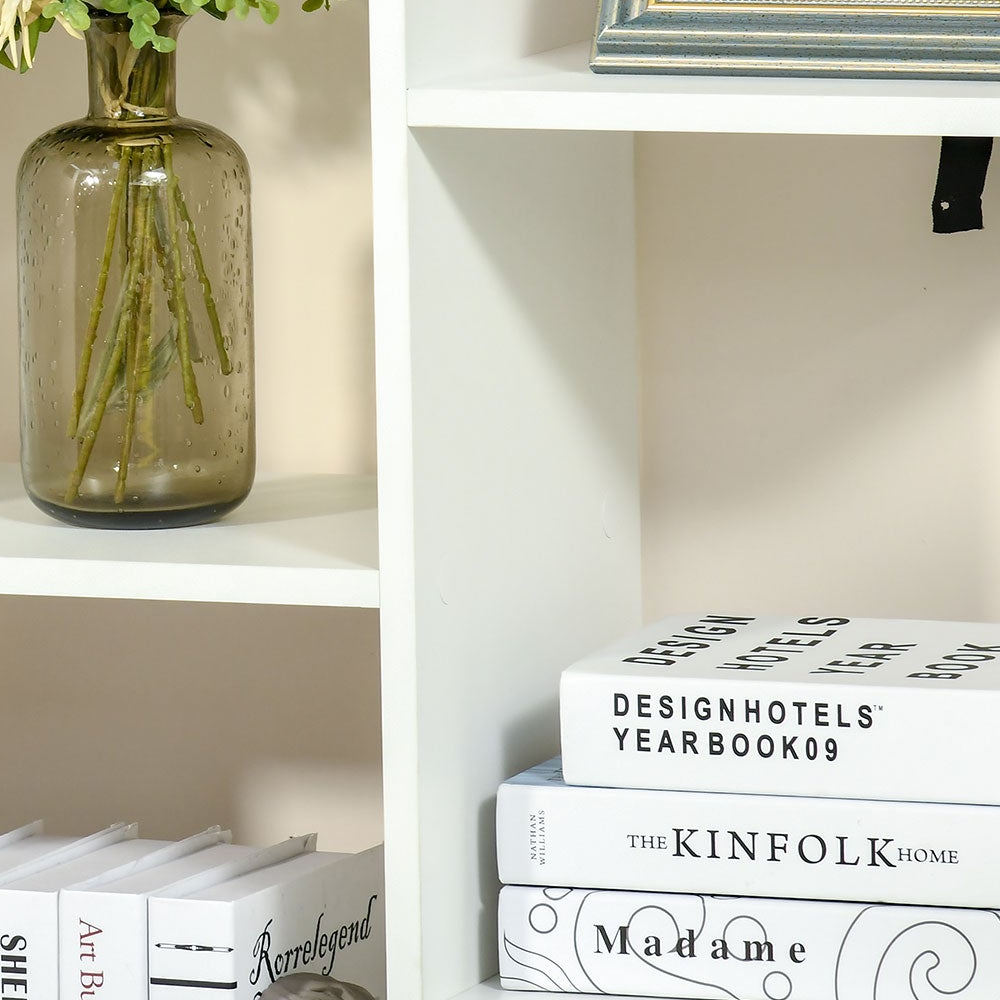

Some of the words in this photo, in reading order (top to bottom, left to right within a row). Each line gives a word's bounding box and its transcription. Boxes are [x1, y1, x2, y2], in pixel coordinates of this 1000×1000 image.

[622, 614, 756, 666] DESIGN
[716, 616, 850, 671] HOTELS
[809, 642, 918, 674] YEAR
[907, 643, 1000, 679] BOOK
[529, 814, 537, 860] NATHAN
[538, 810, 546, 866] WILLIAMS
[627, 833, 667, 850] THE
[671, 828, 897, 868] KINFOLK
[897, 846, 959, 864] HOME
[79, 917, 103, 962] Art
[593, 923, 807, 964] Madame
[0, 934, 28, 1000] SHE
